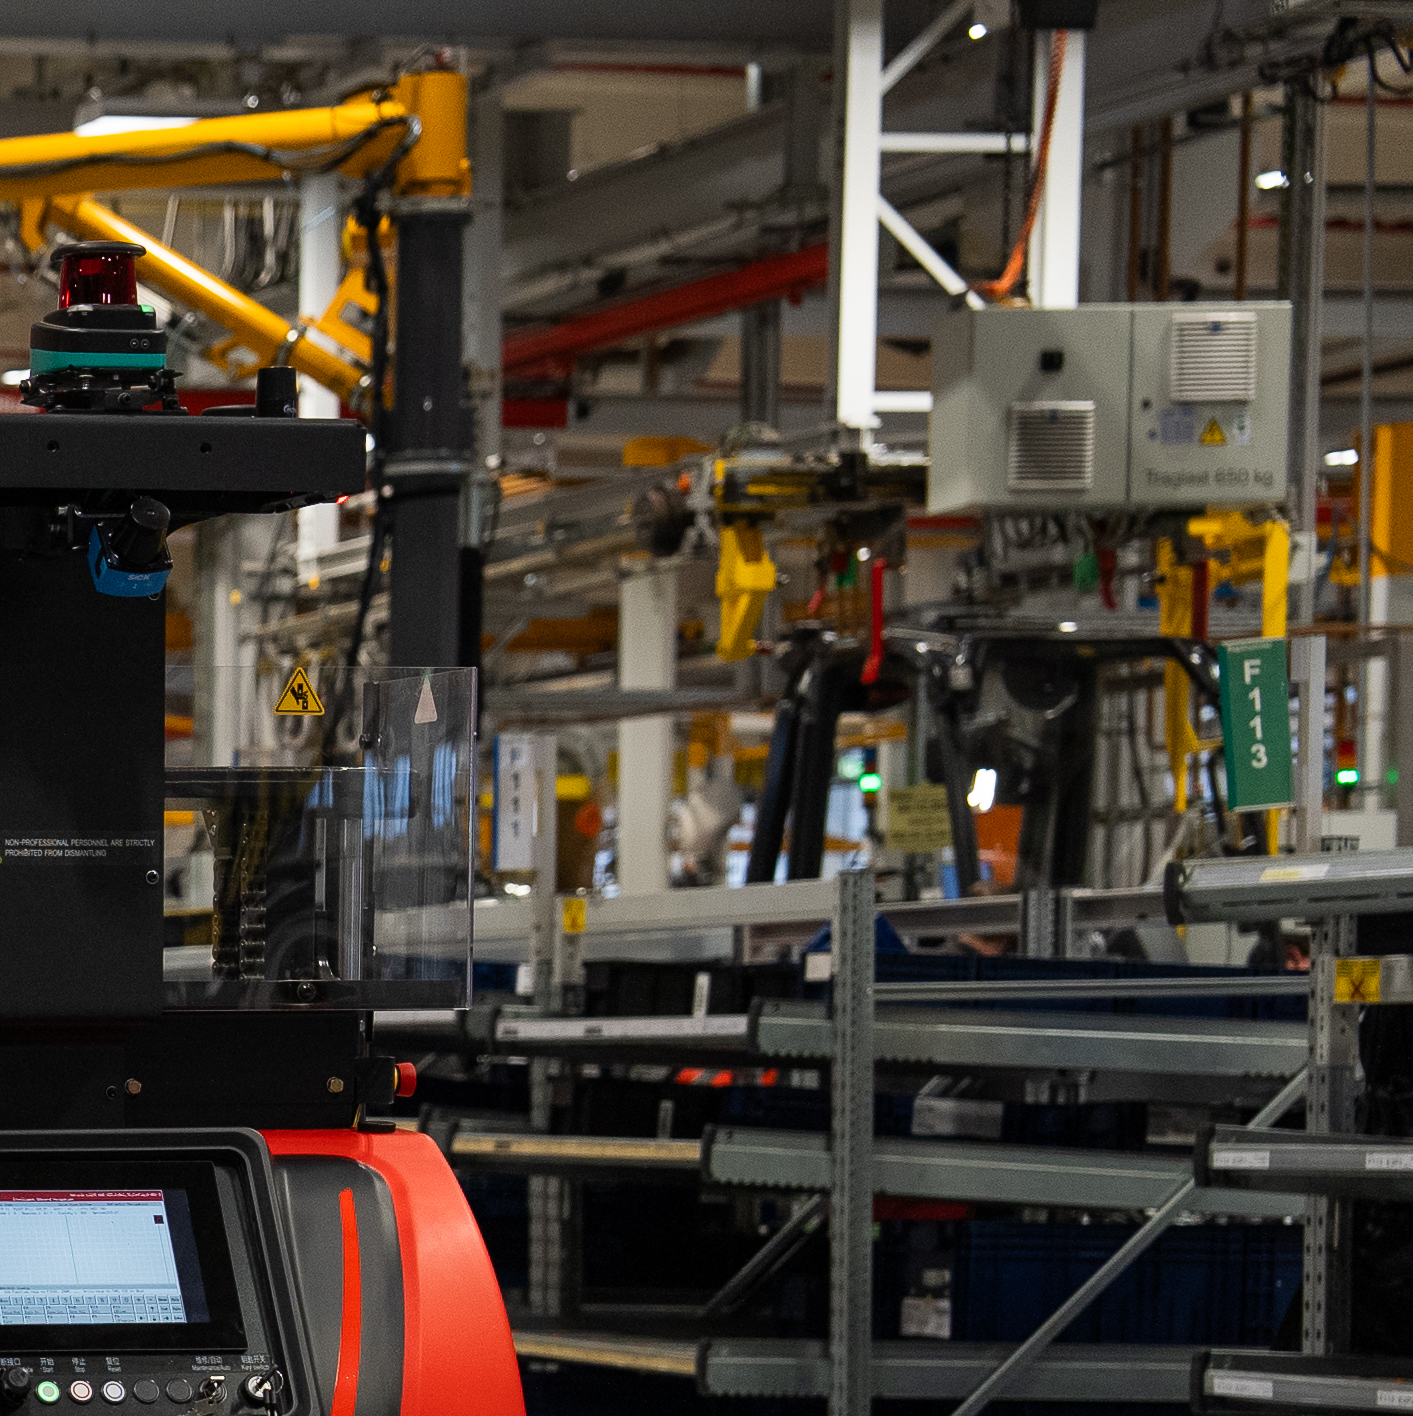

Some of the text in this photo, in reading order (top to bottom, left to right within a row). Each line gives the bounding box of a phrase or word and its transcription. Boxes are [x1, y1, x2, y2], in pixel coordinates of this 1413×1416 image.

[1243, 658, 1268, 770] F113
[4, 838, 155, 847] NON-PROFESSIONAL PERSONNEL ARE STRICTLY
[4, 849, 107, 857] PROHIBITED FROM DISMANTLING
